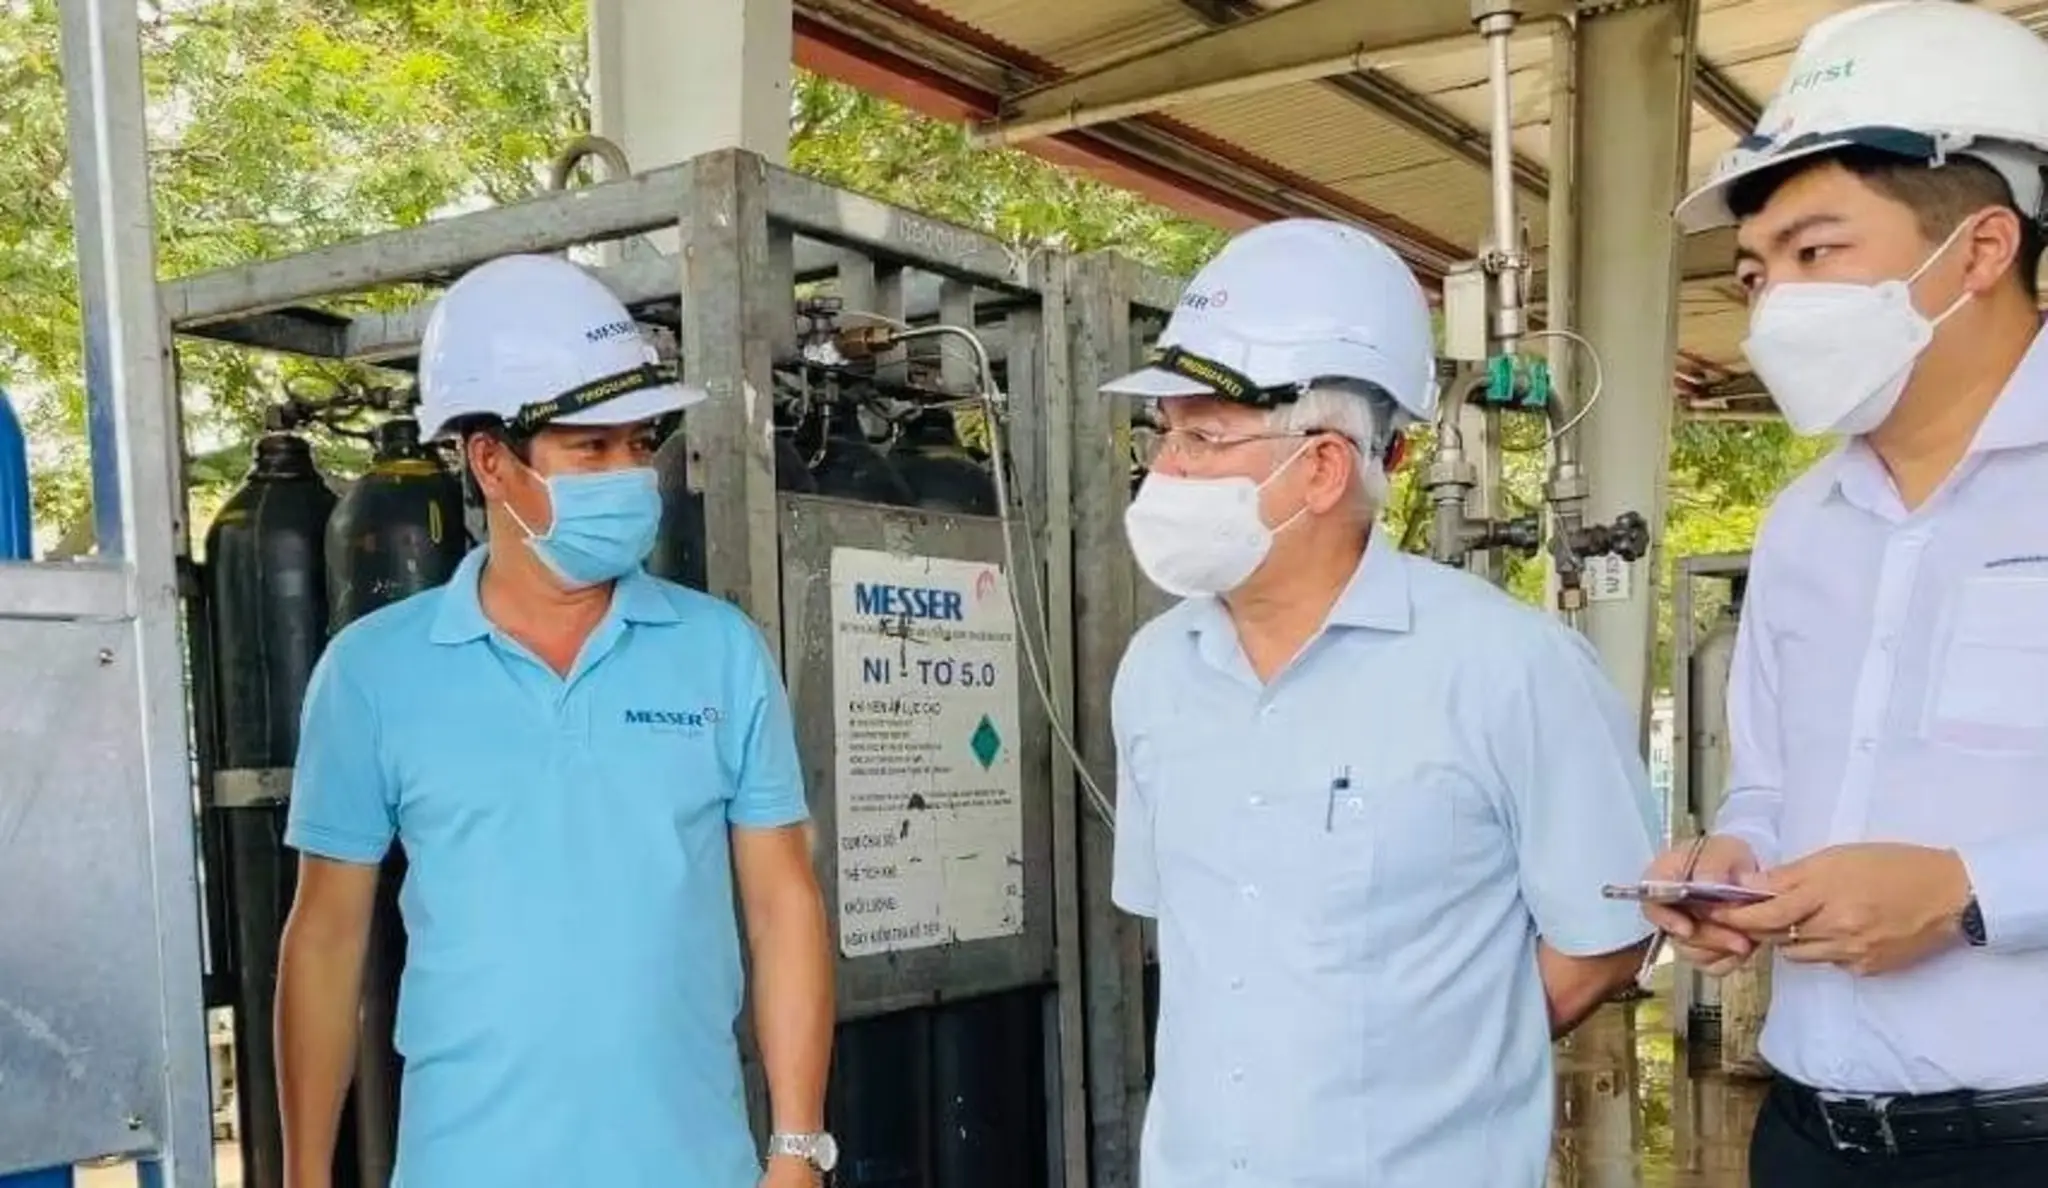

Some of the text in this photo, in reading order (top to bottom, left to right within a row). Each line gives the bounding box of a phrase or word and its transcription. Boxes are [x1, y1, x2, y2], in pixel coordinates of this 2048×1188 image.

[855, 582, 963, 621] MESSER
[863, 657, 891, 685] NI
[961, 663, 996, 688] 5.0
[624, 709, 704, 728] MESSER
